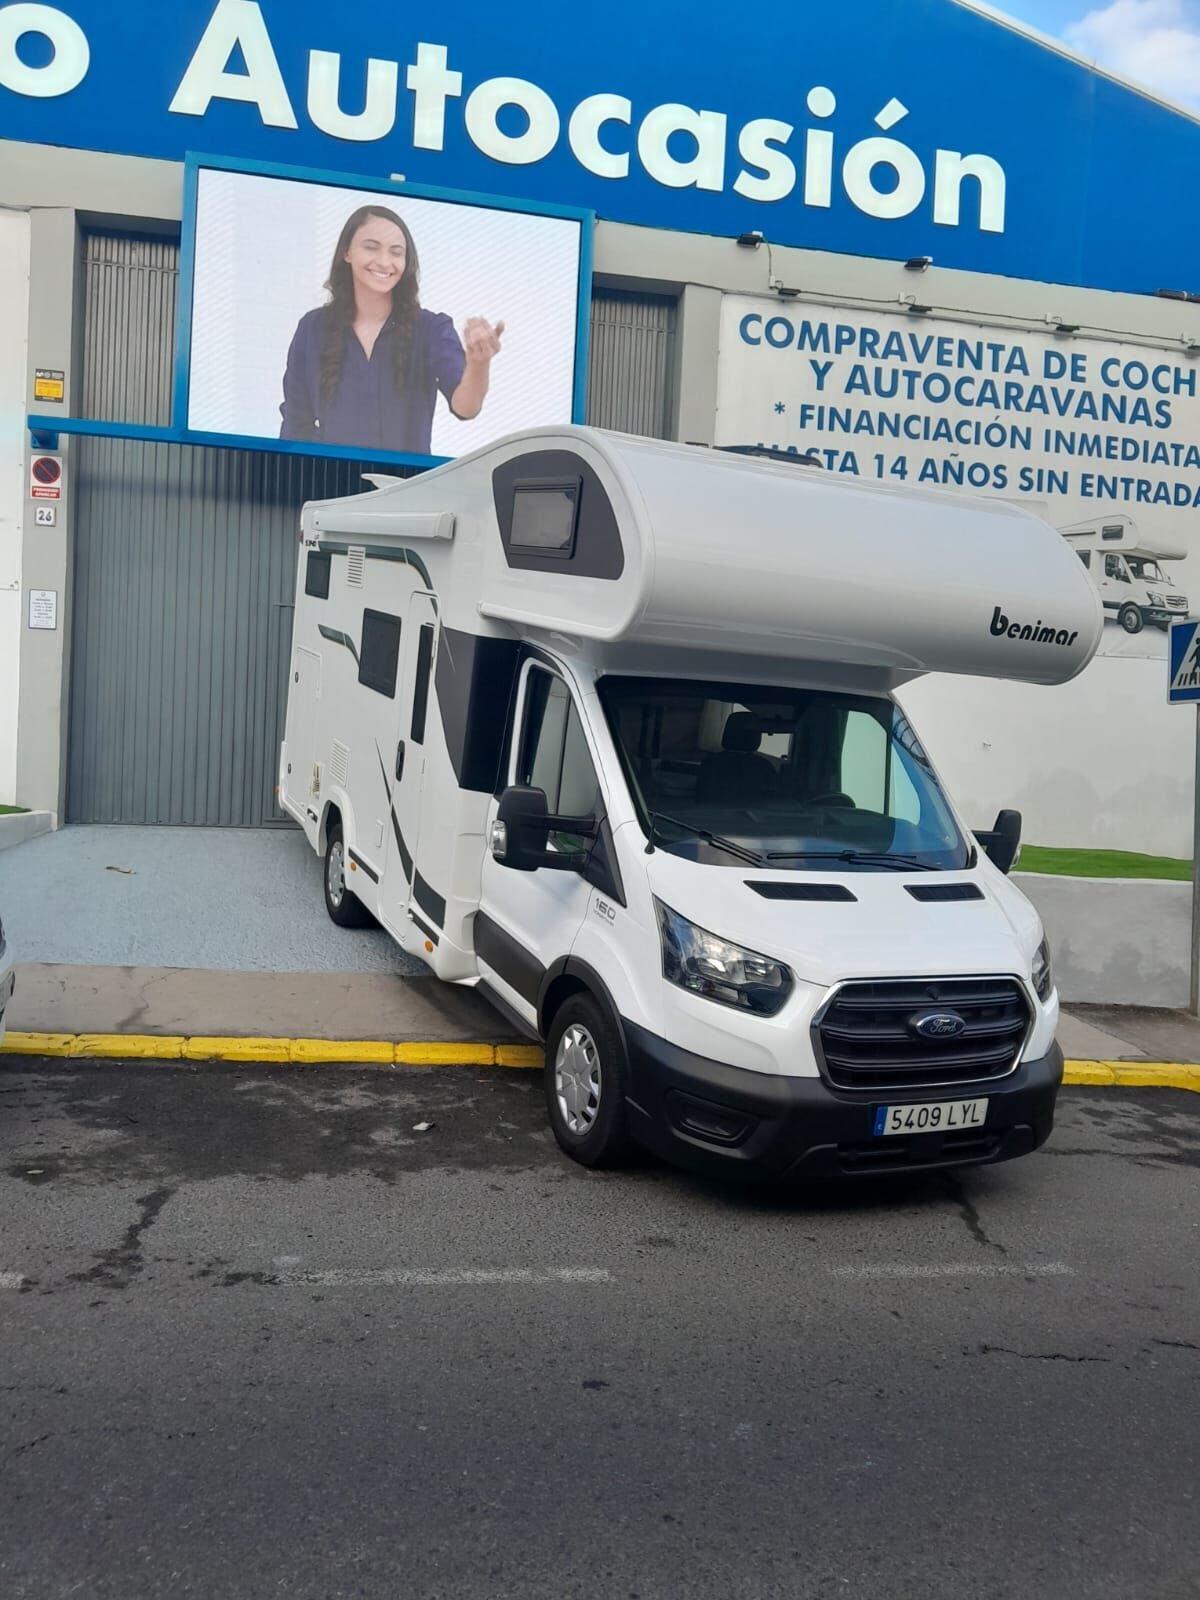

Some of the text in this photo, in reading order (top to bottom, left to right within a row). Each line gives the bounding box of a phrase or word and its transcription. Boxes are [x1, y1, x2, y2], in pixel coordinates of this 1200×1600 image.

[169, 0, 1006, 233] Autocasión
[739, 313, 1197, 397] COMPRAVENTA DE COCH
[810, 359, 1172, 429] Y AUTOCARAVANAS
[799, 406, 1200, 469] FINANCIACIÓN INMEDIATA
[875, 454, 908, 480] 14
[918, 453, 1008, 490] AÑOS
[1019, 467, 1068, 494] SIN
[38, 510, 52, 522] 26
[990, 606, 1079, 646] benimar
[595, 897, 616, 920] 160
[930, 1018, 957, 1033] Ford
[890, 1103, 980, 1131] 5409 LYL
